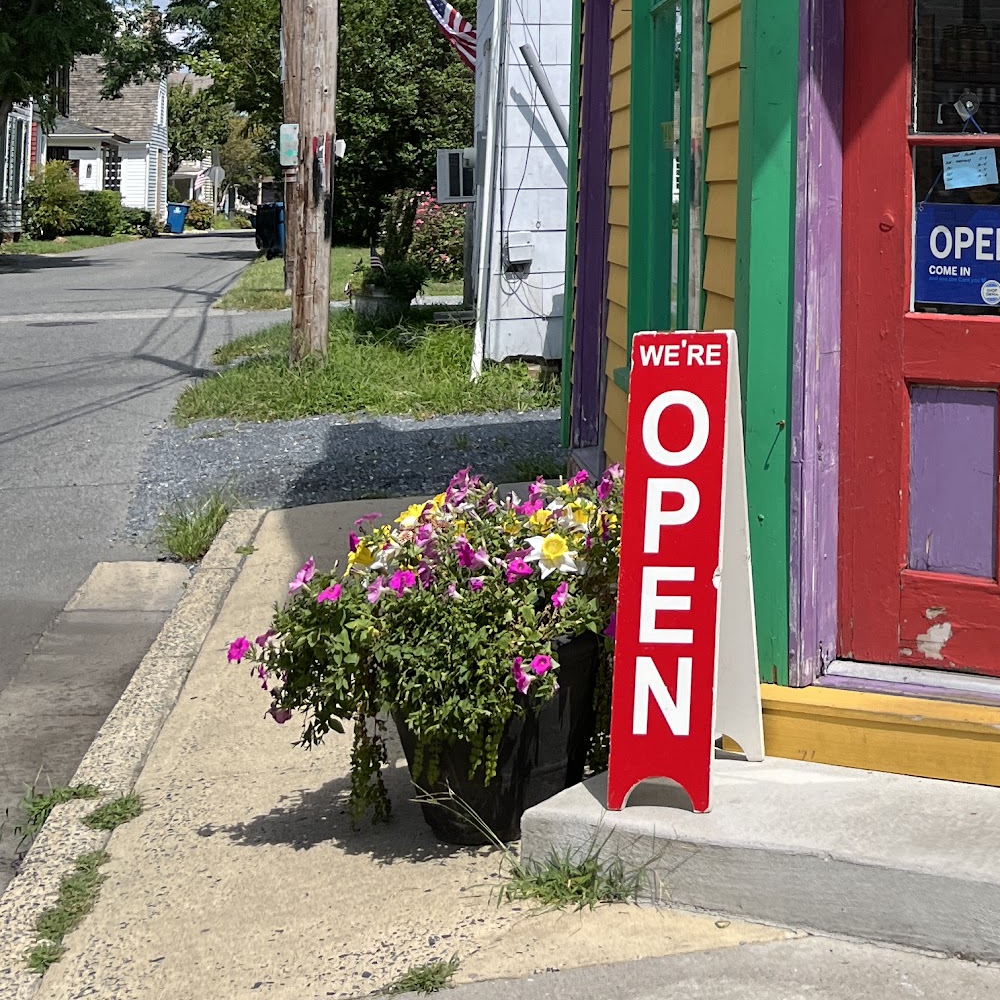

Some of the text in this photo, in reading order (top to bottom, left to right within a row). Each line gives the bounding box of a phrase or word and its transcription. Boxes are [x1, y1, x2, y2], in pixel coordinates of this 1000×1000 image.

[928, 265, 971, 277] COME IN
[640, 339, 722, 367] WE'RE
[632, 390, 710, 737] OPEN
